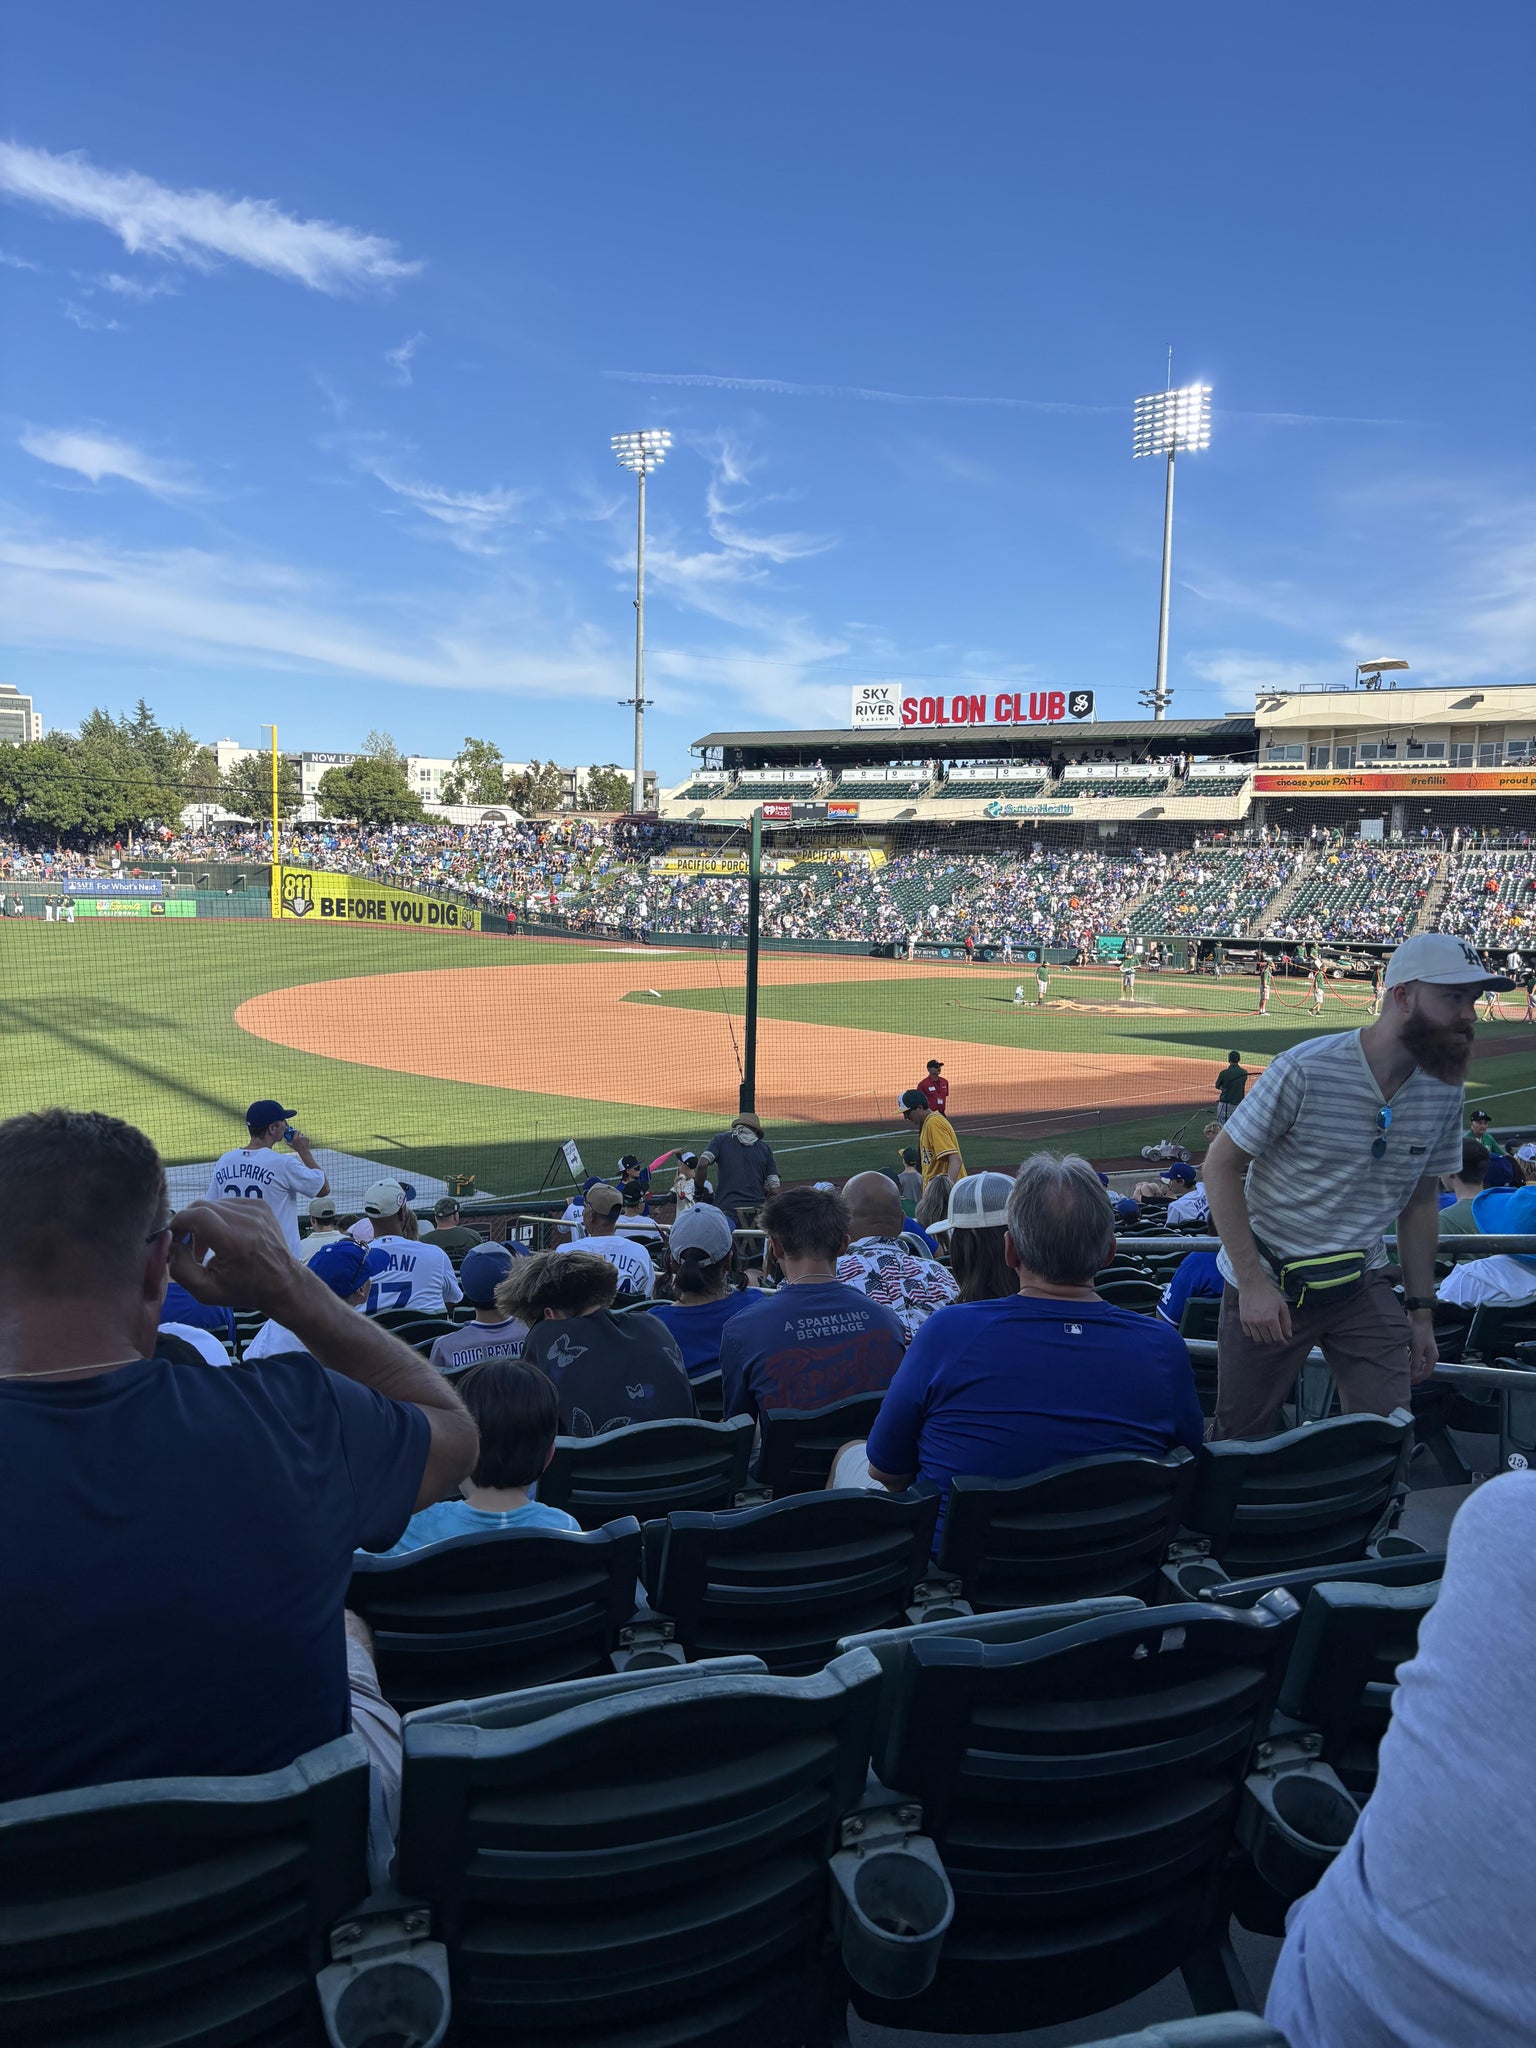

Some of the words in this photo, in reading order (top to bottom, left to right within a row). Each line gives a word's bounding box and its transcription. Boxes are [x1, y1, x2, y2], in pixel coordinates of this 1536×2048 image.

[862, 688, 889, 700] SKY
[856, 704, 895, 716] RIVER
[902, 694, 987, 725] SOLON
[994, 691, 1066, 722] CLUB
[311, 753, 336, 762] NOW
[1276, 778, 1307, 786] choose
[1308, 779, 1330, 787] your
[1332, 777, 1365, 786] PATH.
[1499, 776, 1528, 785] proud
[836, 834, 863, 845] PORCH
[802, 849, 841, 860] PACIFICO
[677, 859, 717, 871] PACIFICO
[721, 860, 750, 871] PORCH
[96, 883, 109, 891] For
[112, 883, 138, 891] What's
[283, 874, 312, 901] 811
[321, 897, 387, 921] BEFORE
[390, 901, 423, 924] YOU
[427, 903, 458, 926] DIG
[1458, 943, 1482, 967] LA
[216, 1163, 275, 1185] BALLPARKS
[366, 1281, 413, 1315] 17
[784, 1321, 794, 1332] A
[797, 1311, 870, 1329] SPARKLING
[796, 1321, 866, 1341] BEVERAGE
